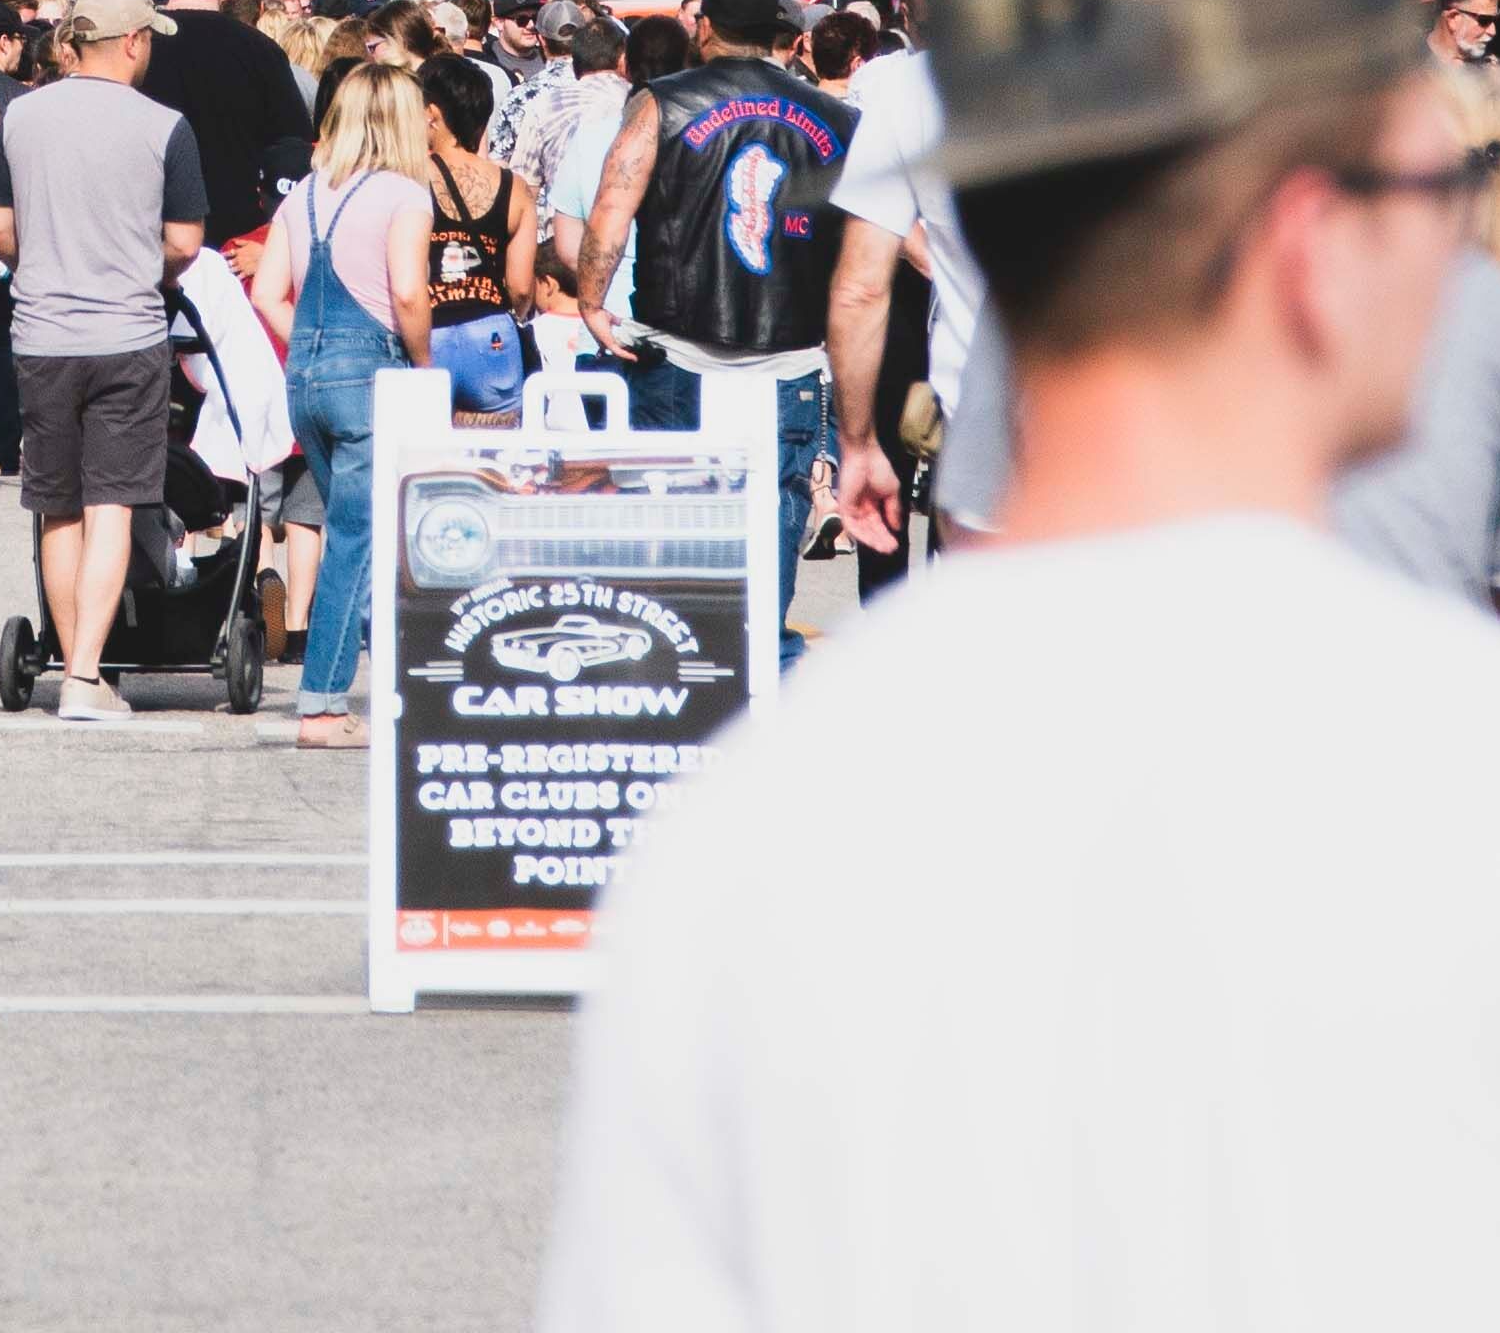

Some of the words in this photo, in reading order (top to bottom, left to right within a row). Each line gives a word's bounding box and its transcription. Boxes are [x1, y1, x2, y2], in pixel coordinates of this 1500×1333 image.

[784, 104, 834, 157] Limits
[785, 215, 809, 235] MC
[445, 585, 544, 653] HISTORIC
[549, 582, 613, 609] 25TH
[616, 590, 699, 654] STREET
[453, 685, 549, 716] CAR
[554, 685, 688, 716] SHOW
[418, 781, 494, 810] CAR
[500, 781, 619, 810] CLUBS
[450, 817, 601, 847] BEYOND
